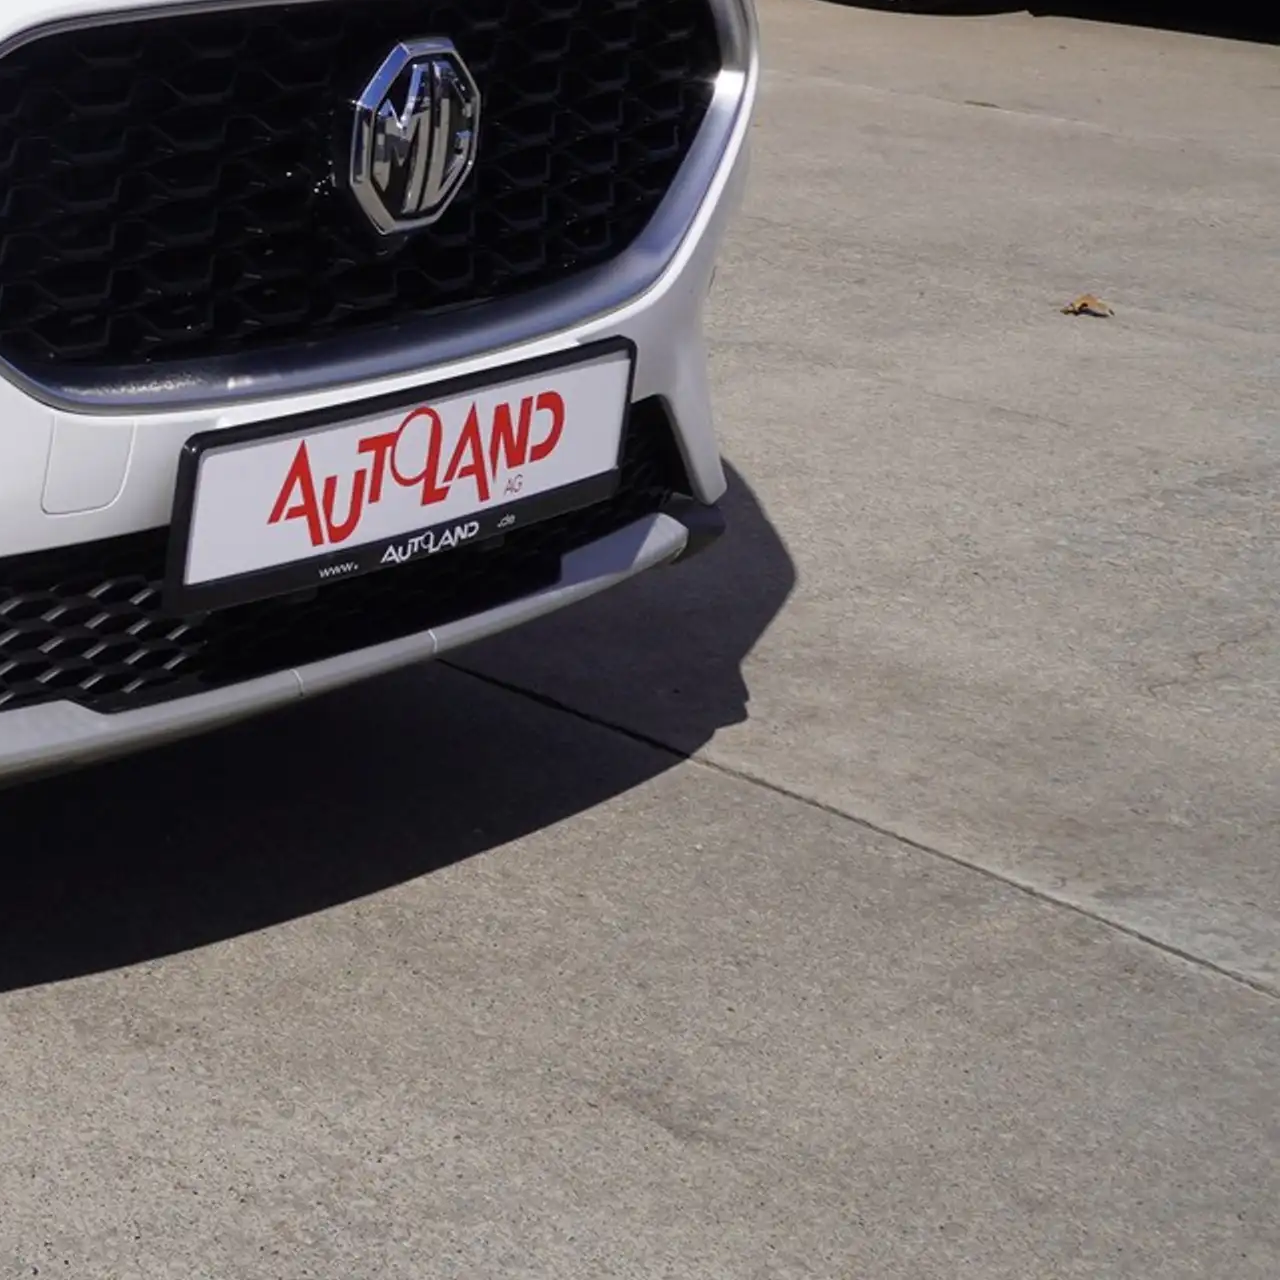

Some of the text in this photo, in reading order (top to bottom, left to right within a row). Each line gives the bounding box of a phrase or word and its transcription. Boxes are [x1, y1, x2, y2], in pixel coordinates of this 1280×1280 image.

[373, 61, 472, 213] MG
[267, 391, 565, 547] AUTOLAND
[503, 474, 524, 495] AG
[319, 561, 359, 578] www.
[380, 521, 480, 564] AUTOLAND
